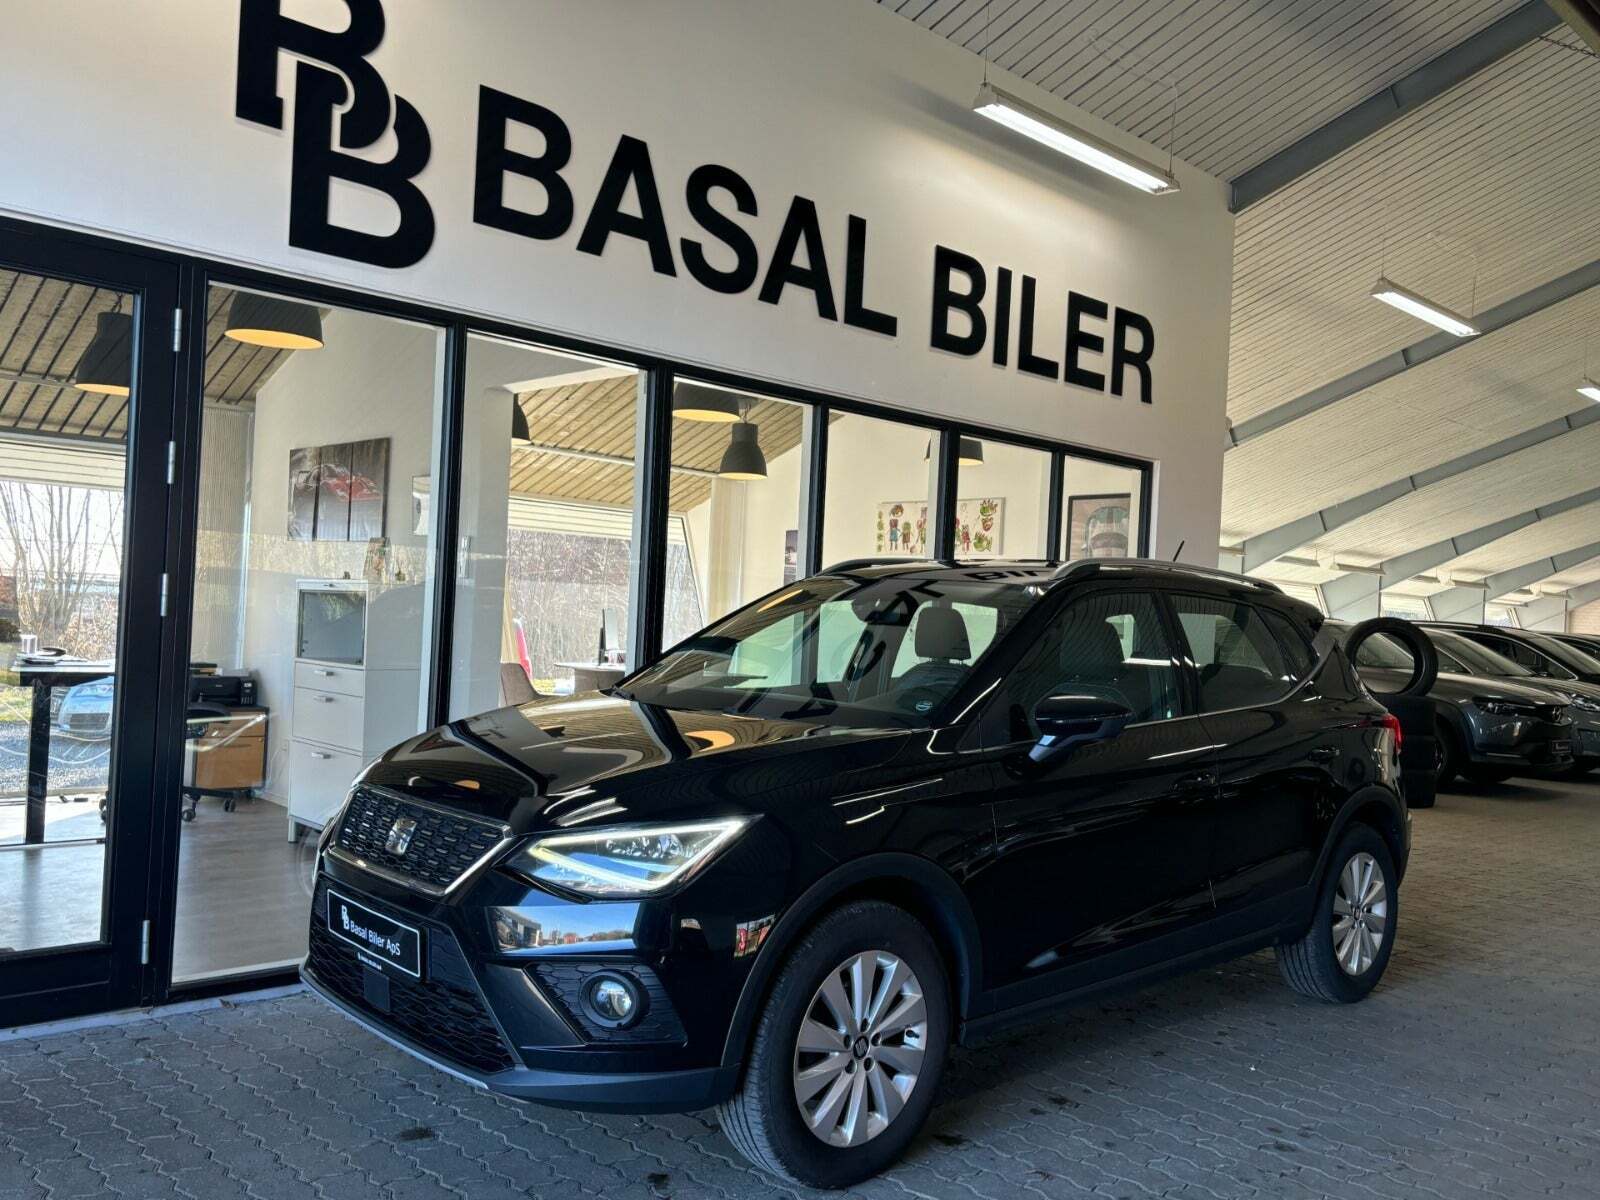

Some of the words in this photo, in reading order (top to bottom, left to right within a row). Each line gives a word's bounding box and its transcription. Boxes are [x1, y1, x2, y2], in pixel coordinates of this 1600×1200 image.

[473, 84, 898, 337] BASAL
[930, 244, 1155, 405] BILER
[350, 921, 367, 939] Basal
[368, 930, 384, 947] Biler
[386, 939, 401, 956] ApS
